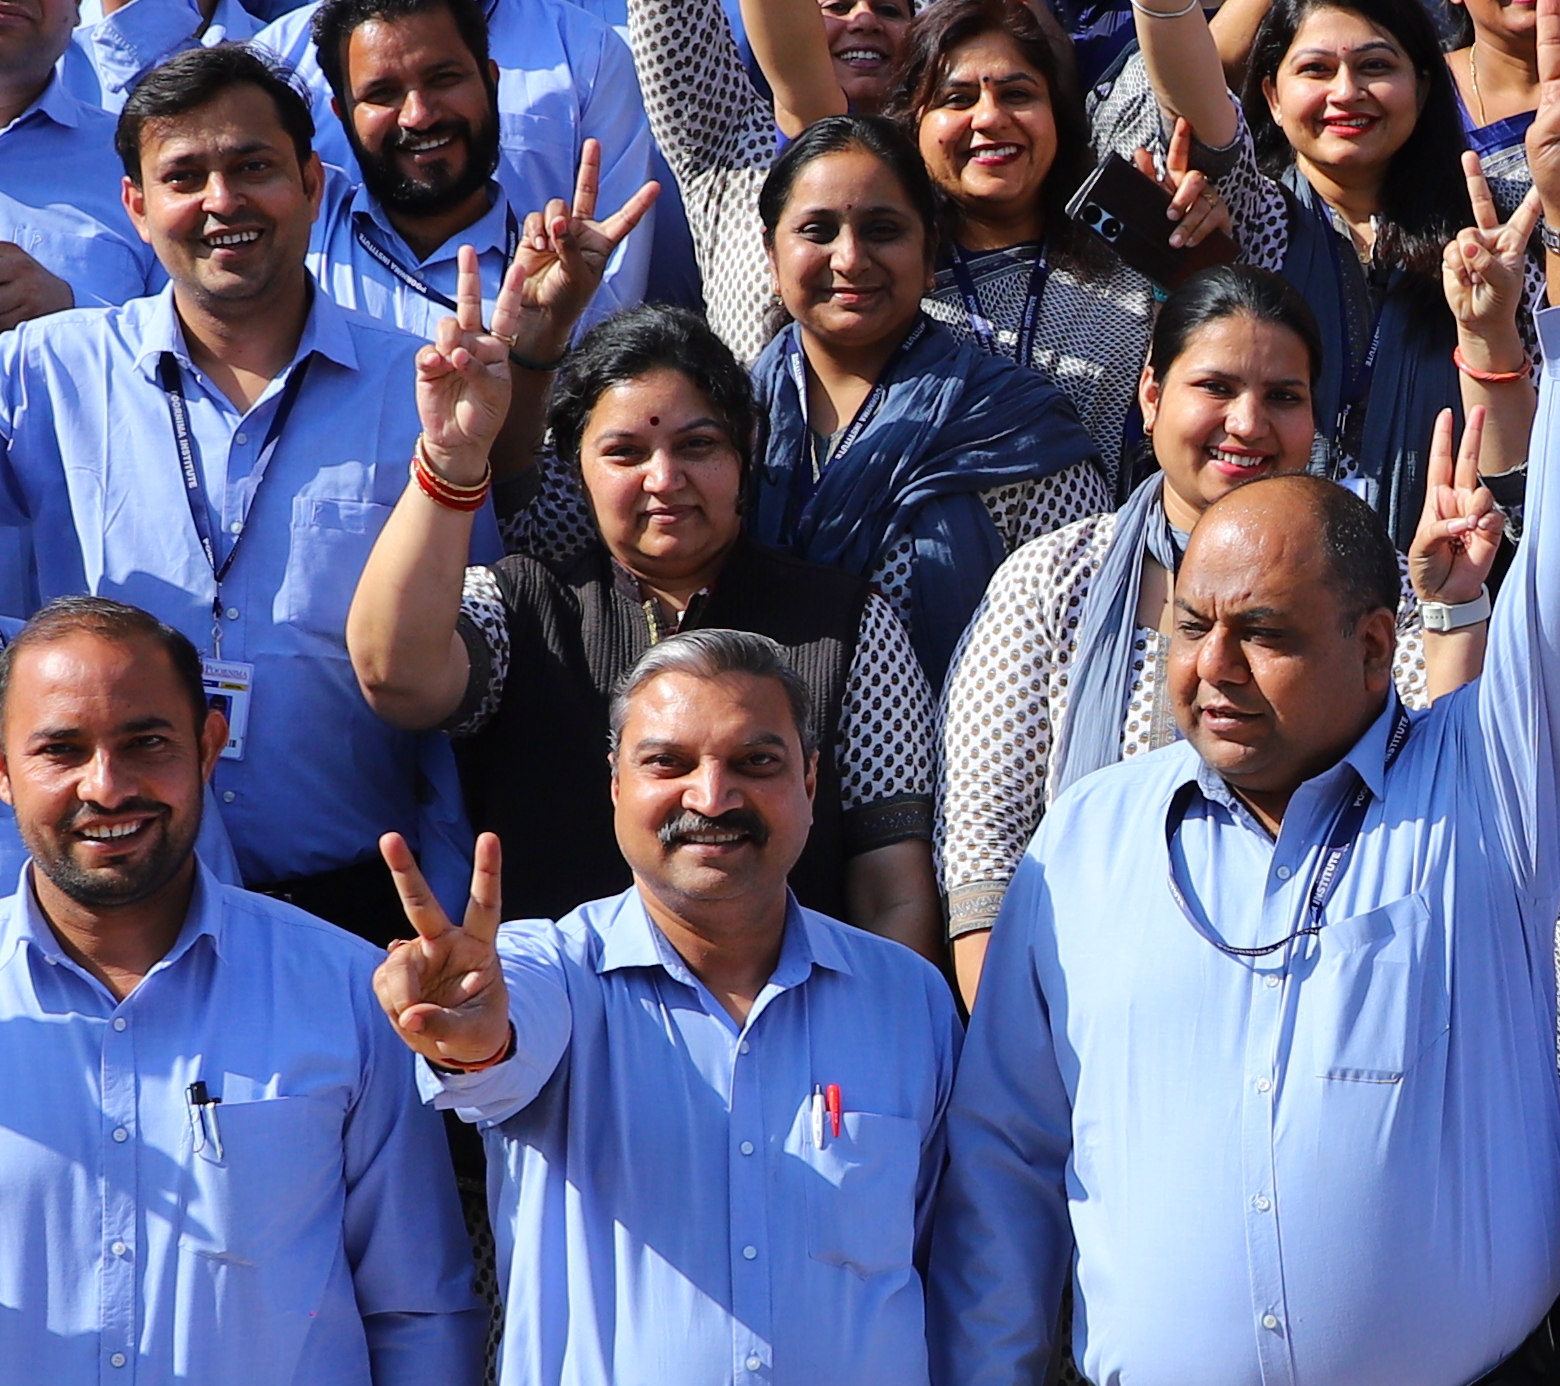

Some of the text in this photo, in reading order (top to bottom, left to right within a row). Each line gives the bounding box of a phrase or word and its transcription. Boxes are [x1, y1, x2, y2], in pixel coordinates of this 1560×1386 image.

[358, 232, 428, 294] POORNIMA INSTITUTE
[177, 438, 198, 489] INSTITUTE
[834, 422, 863, 460] INSTITUTE
[1314, 851, 1341, 905] INSTITUTE
